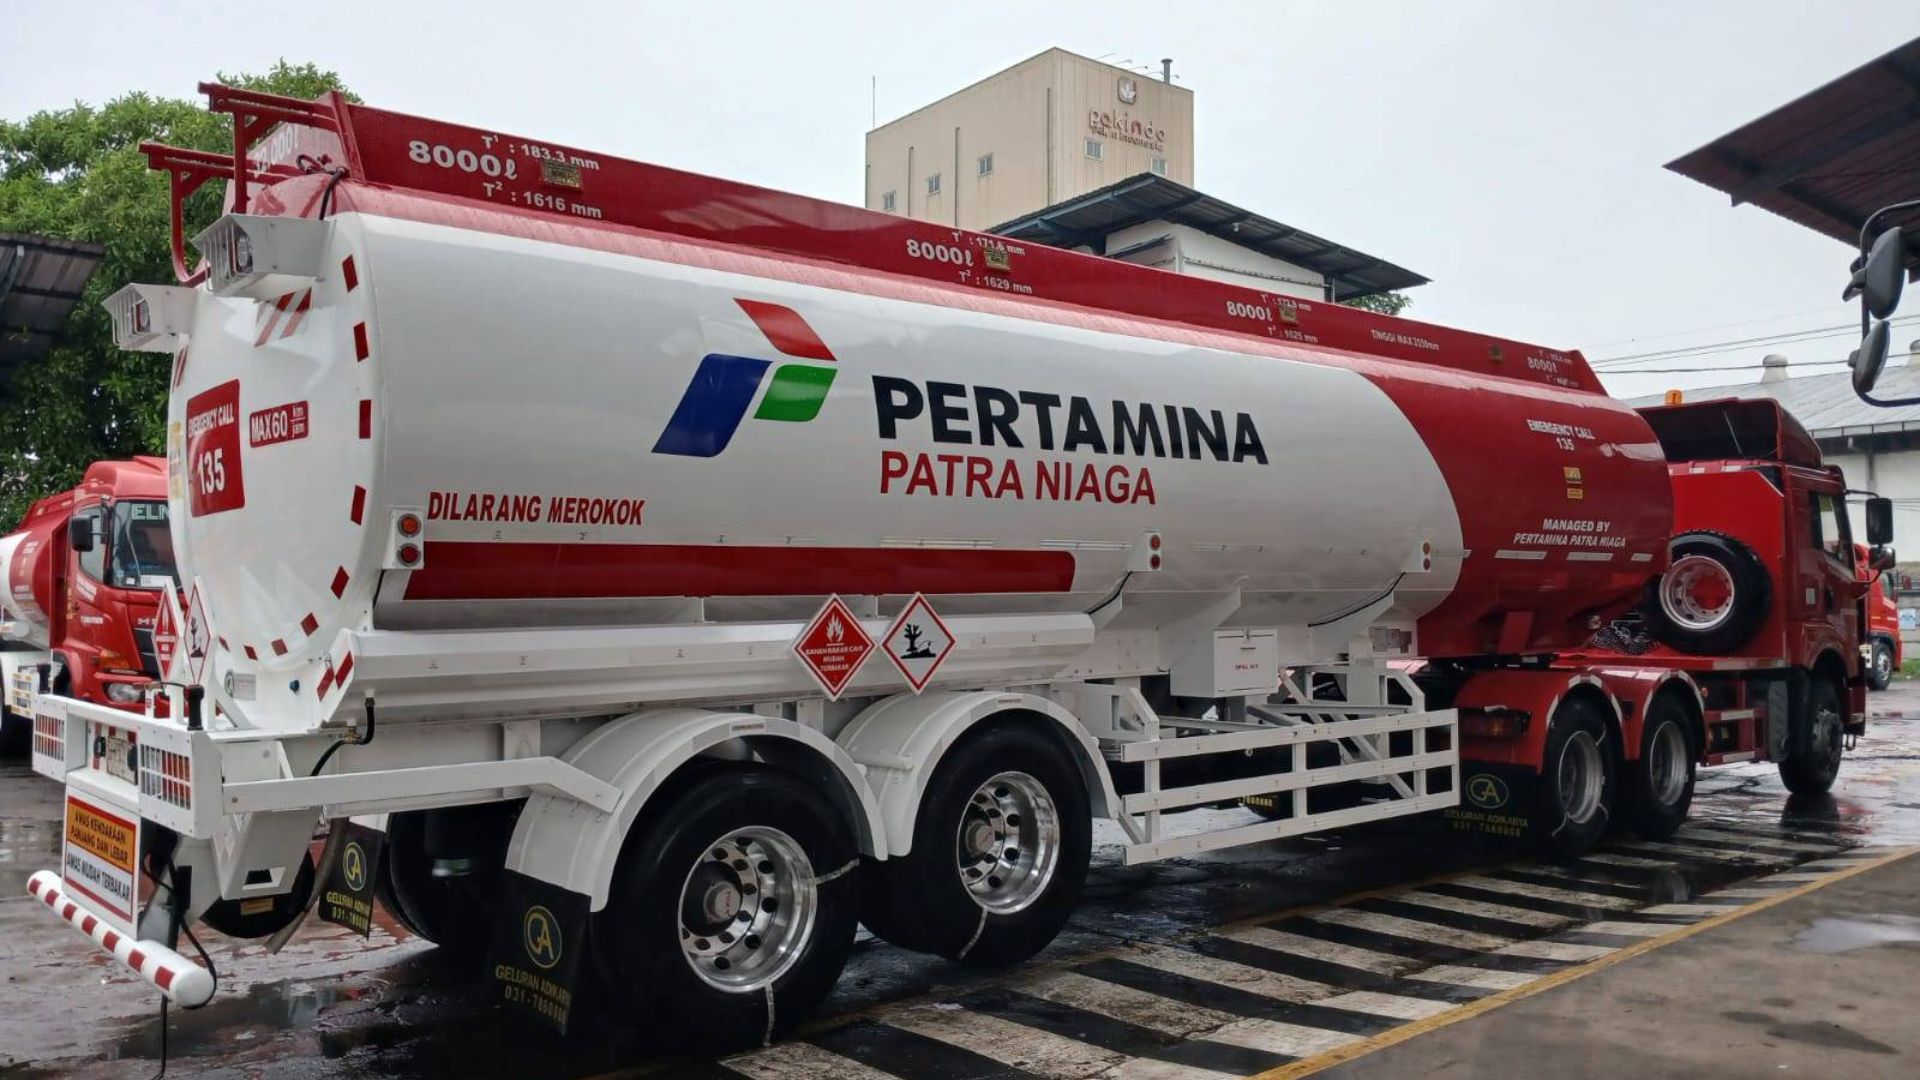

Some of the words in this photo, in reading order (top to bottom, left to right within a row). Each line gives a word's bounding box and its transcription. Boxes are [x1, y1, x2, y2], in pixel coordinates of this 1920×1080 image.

[521, 143, 566, 163] 183.3
[570, 155, 600, 170] mm
[523, 191, 566, 211] 1616
[571, 202, 601, 219] mm
[218, 402, 235, 427] CALL
[251, 413, 272, 442] MAX
[272, 410, 288, 438] 60
[871, 374, 1270, 465] PERTAMINA
[1526, 419, 1574, 437] EMERGENCY
[1575, 426, 1596, 440] CALL
[1556, 437, 1575, 450] 135
[197, 448, 225, 495] 135
[880, 450, 1024, 499] PATRA
[1036, 460, 1156, 505] NIAGA
[427, 491, 541, 522] DILARANG
[547, 496, 645, 526] MEROKOK
[1542, 518, 1594, 531] MANAGED
[1597, 521, 1611, 533] BY
[1513, 533, 1568, 546] PERTAMINA
[1569, 535, 1598, 547] PATRA
[1599, 536, 1626, 548] NIAGA
[75, 810, 90, 827] AWAS
[90, 816, 126, 845] KENDARAAN
